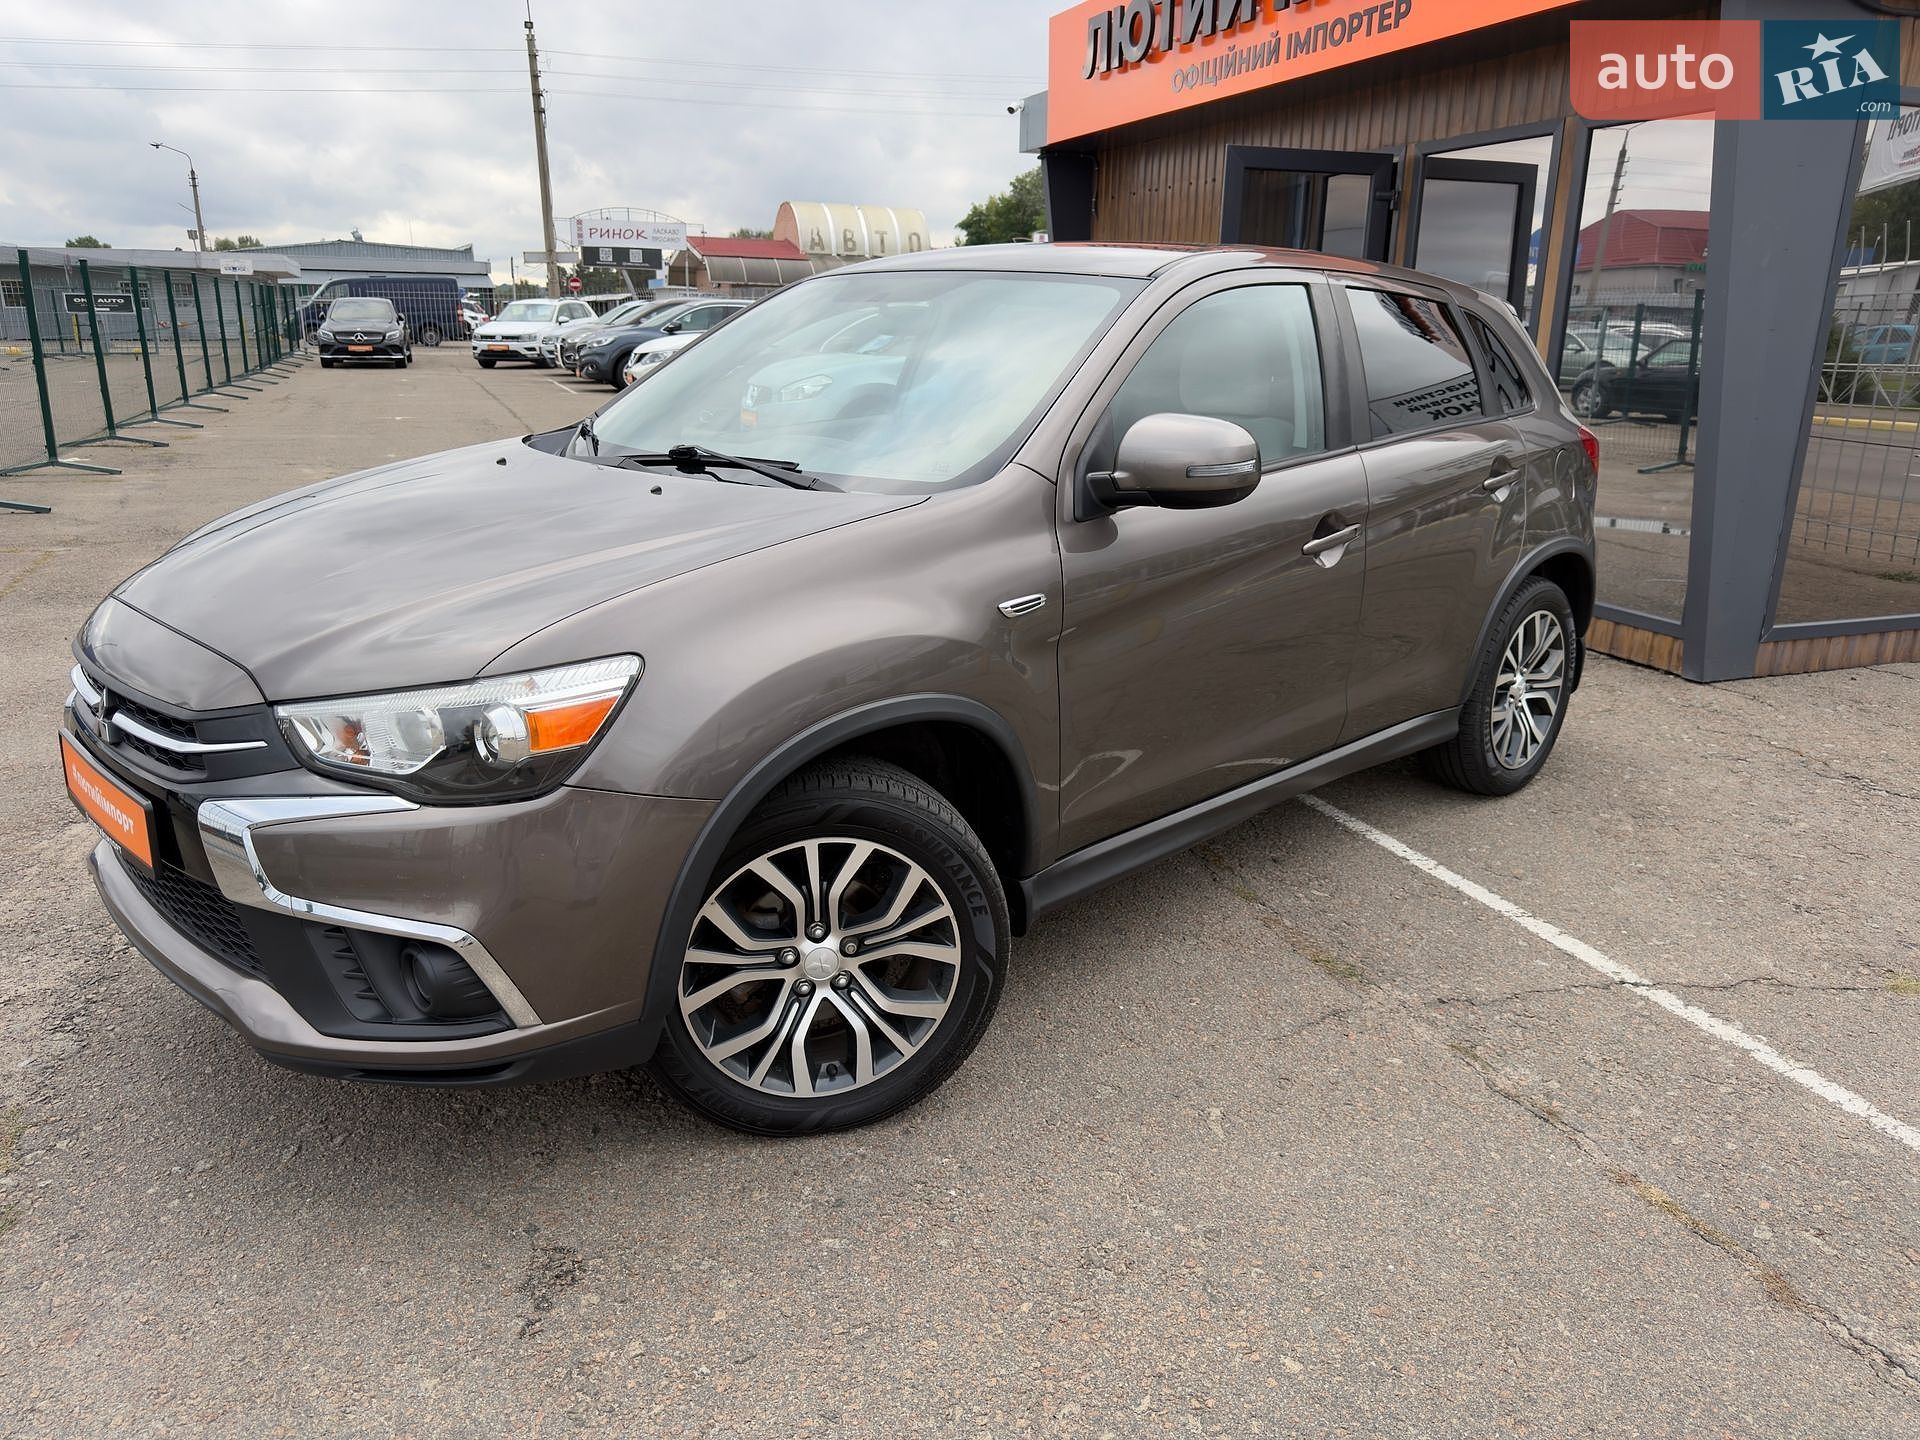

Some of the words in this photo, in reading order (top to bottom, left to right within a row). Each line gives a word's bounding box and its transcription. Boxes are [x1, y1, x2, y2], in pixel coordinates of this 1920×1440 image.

[1171, 30, 1280, 93] ОФІЦІЙНИЙ
[1286, 0, 1413, 60] ІМПОРТЕР
[588, 227, 648, 240] РИНОК
